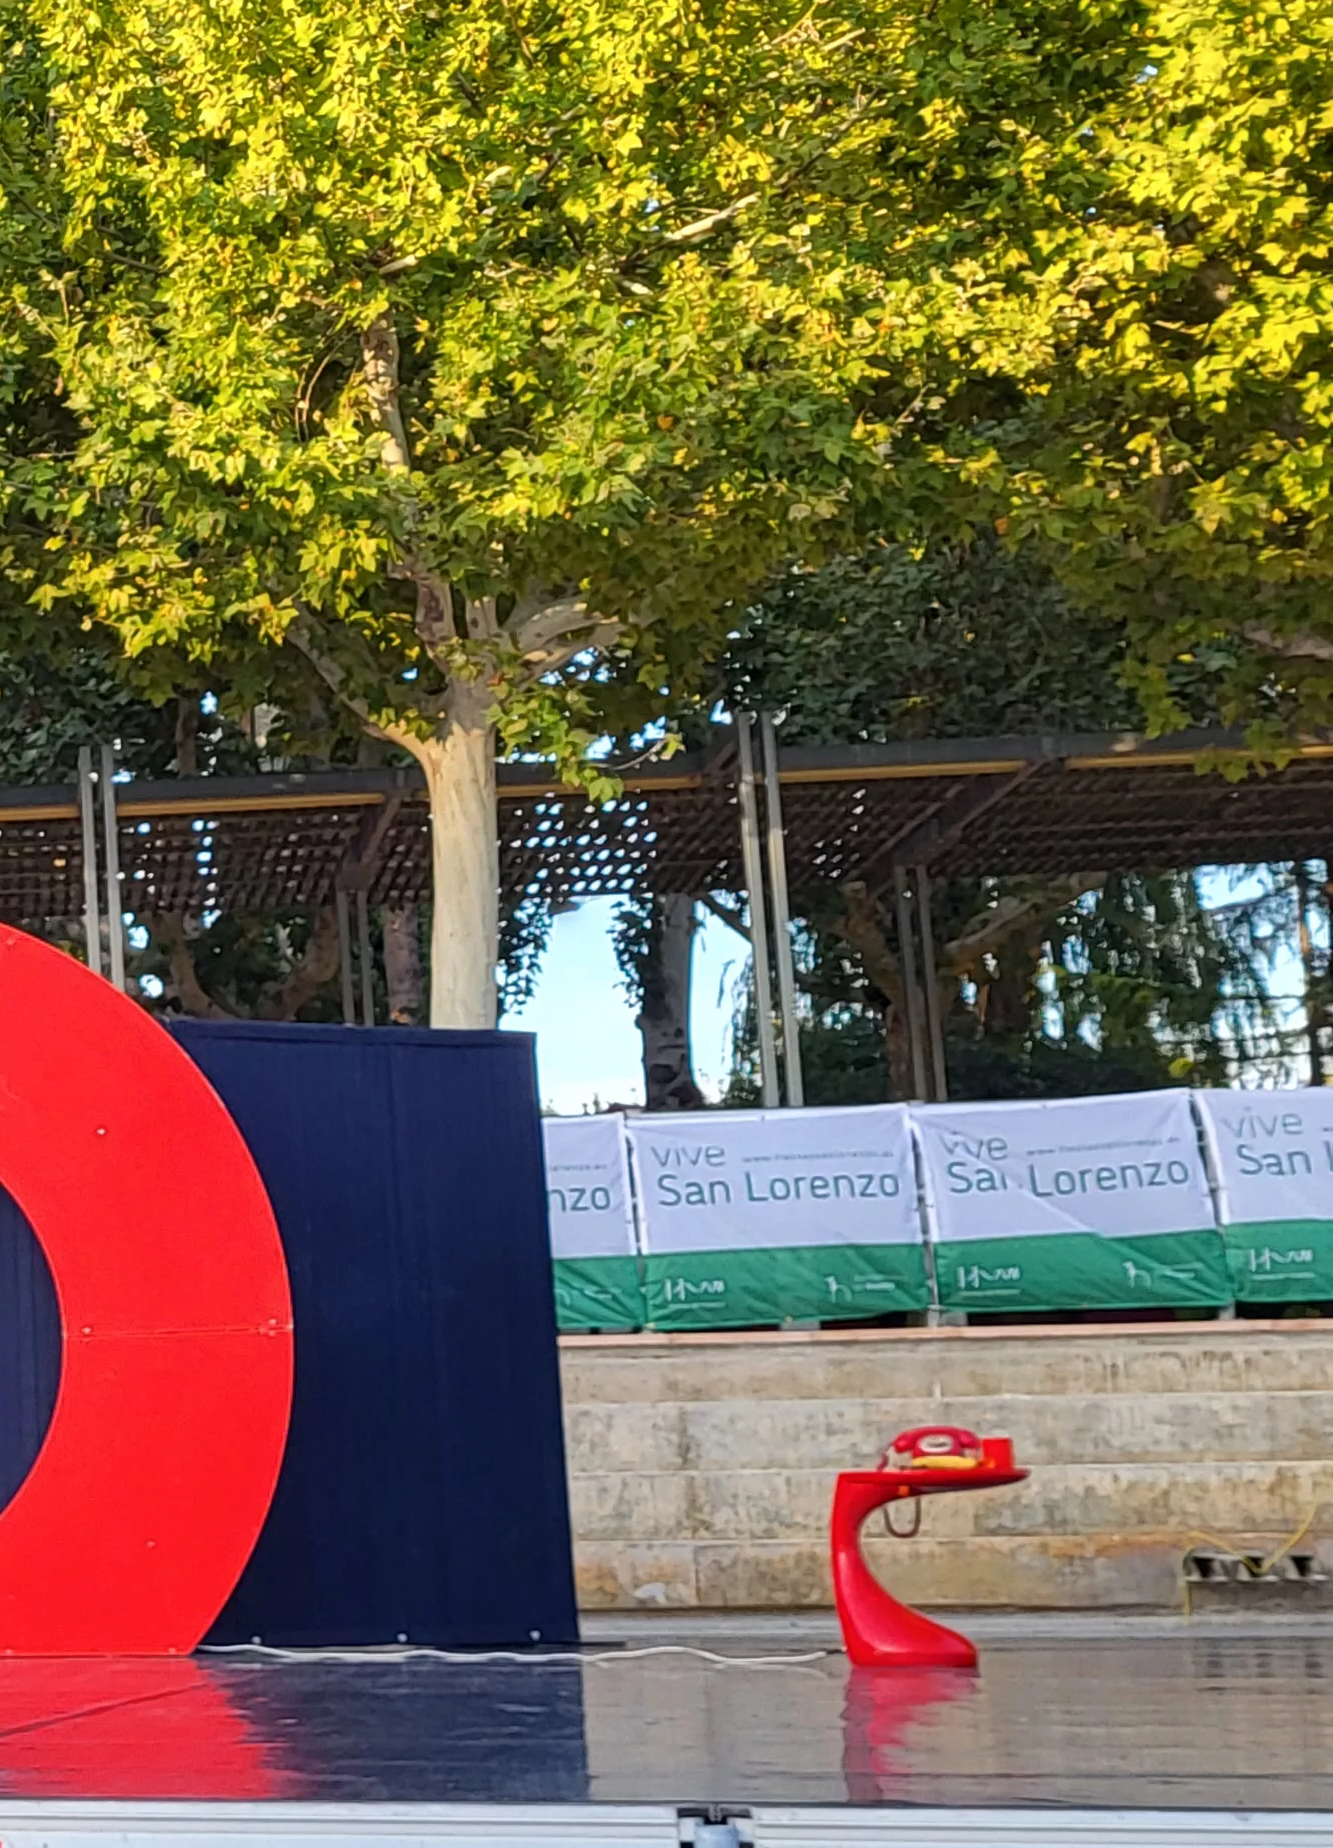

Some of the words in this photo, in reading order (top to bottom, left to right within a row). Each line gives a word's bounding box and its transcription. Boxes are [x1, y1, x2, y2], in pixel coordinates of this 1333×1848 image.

[1221, 1106, 1304, 1138] vive
[652, 1144, 726, 1167] vive
[1237, 1144, 1313, 1176] San
[657, 1174, 732, 1206] San
[744, 1171, 900, 1201] Lorenzo
[1029, 1160, 1189, 1198] Lorenzo
